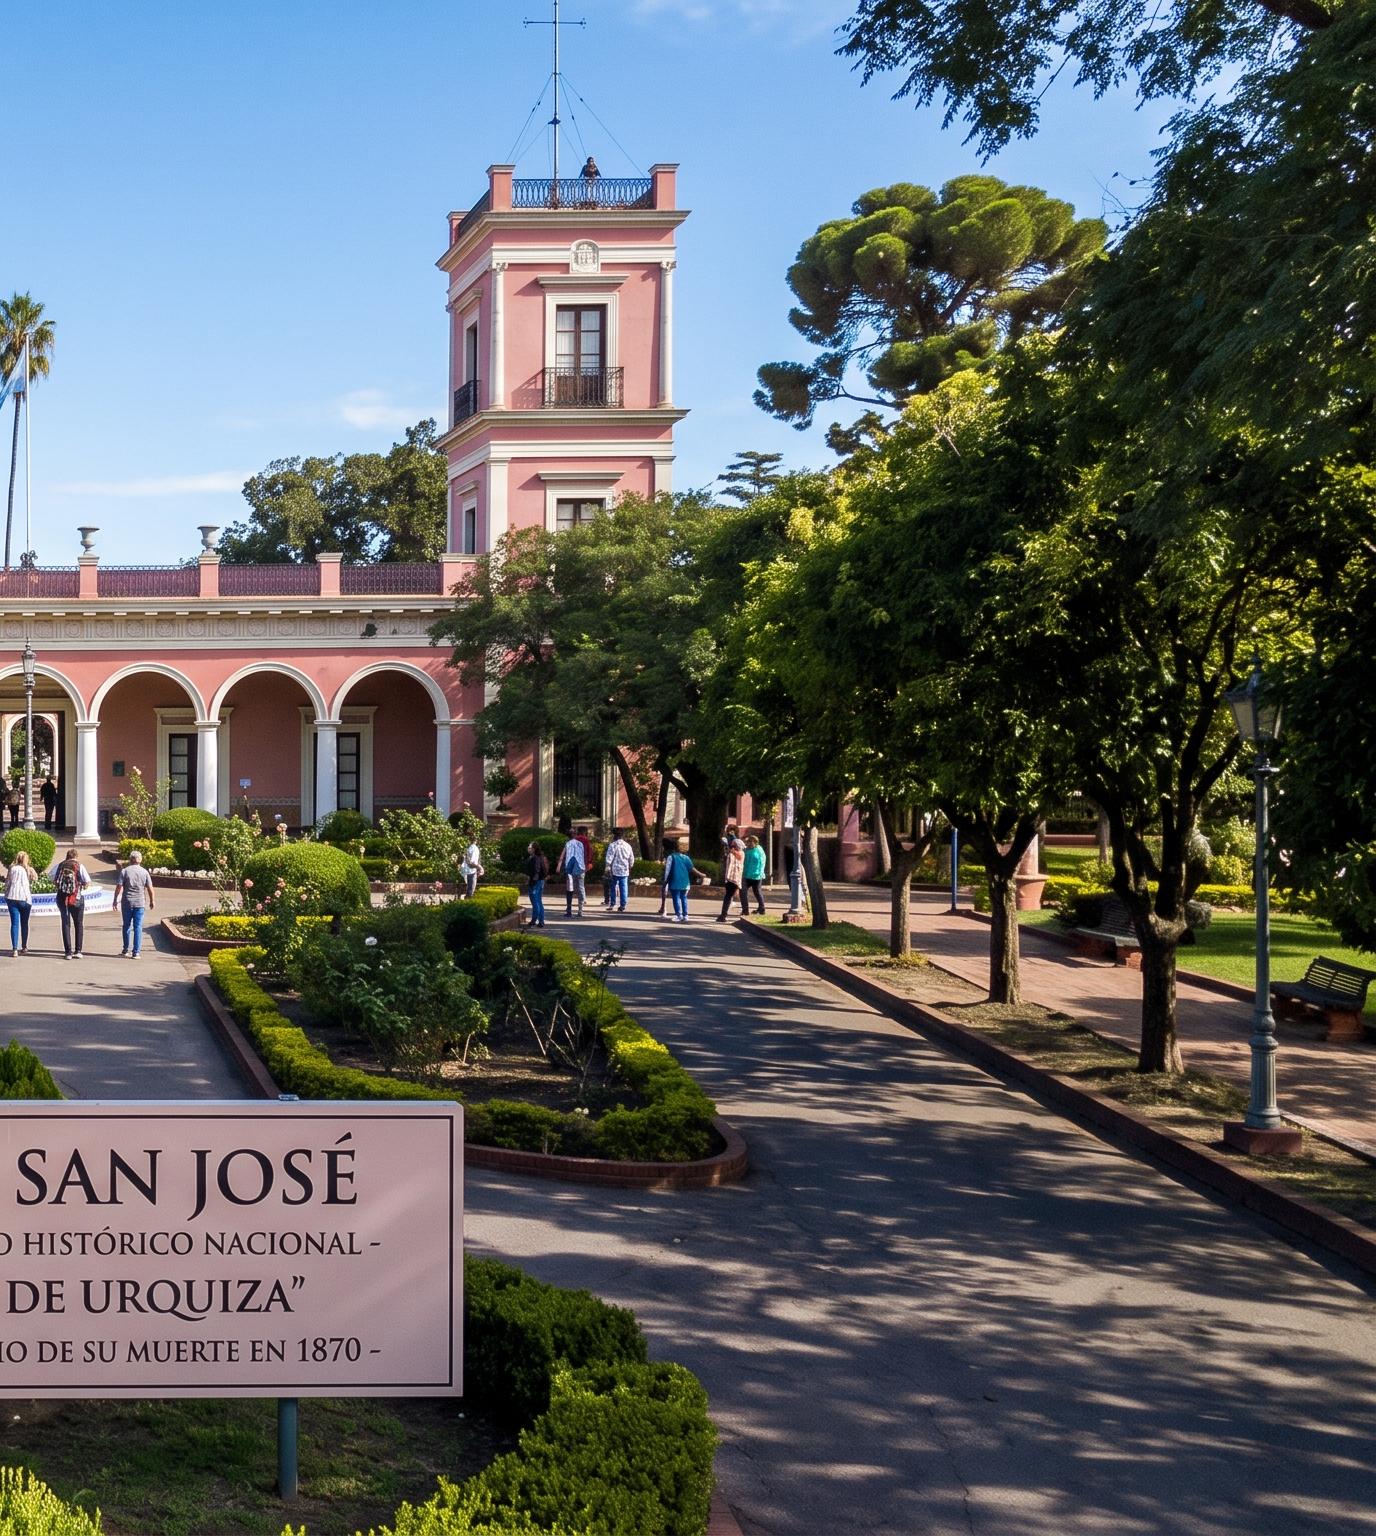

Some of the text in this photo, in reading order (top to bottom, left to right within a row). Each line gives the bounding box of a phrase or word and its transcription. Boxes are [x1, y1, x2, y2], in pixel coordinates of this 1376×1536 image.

[16, 1147, 163, 1206] SAN
[186, 1131, 358, 1222] JOSÉ
[22, 1225, 194, 1256] HISTÓRICO
[203, 1231, 363, 1256] NACIONAL
[5, 1279, 66, 1314] DE
[36, 1340, 74, 1364] DE
[82, 1340, 119, 1364] SU
[125, 1339, 240, 1364] MUERTE
[248, 1339, 287, 1363] EN
[296, 1336, 362, 1363] 1870
